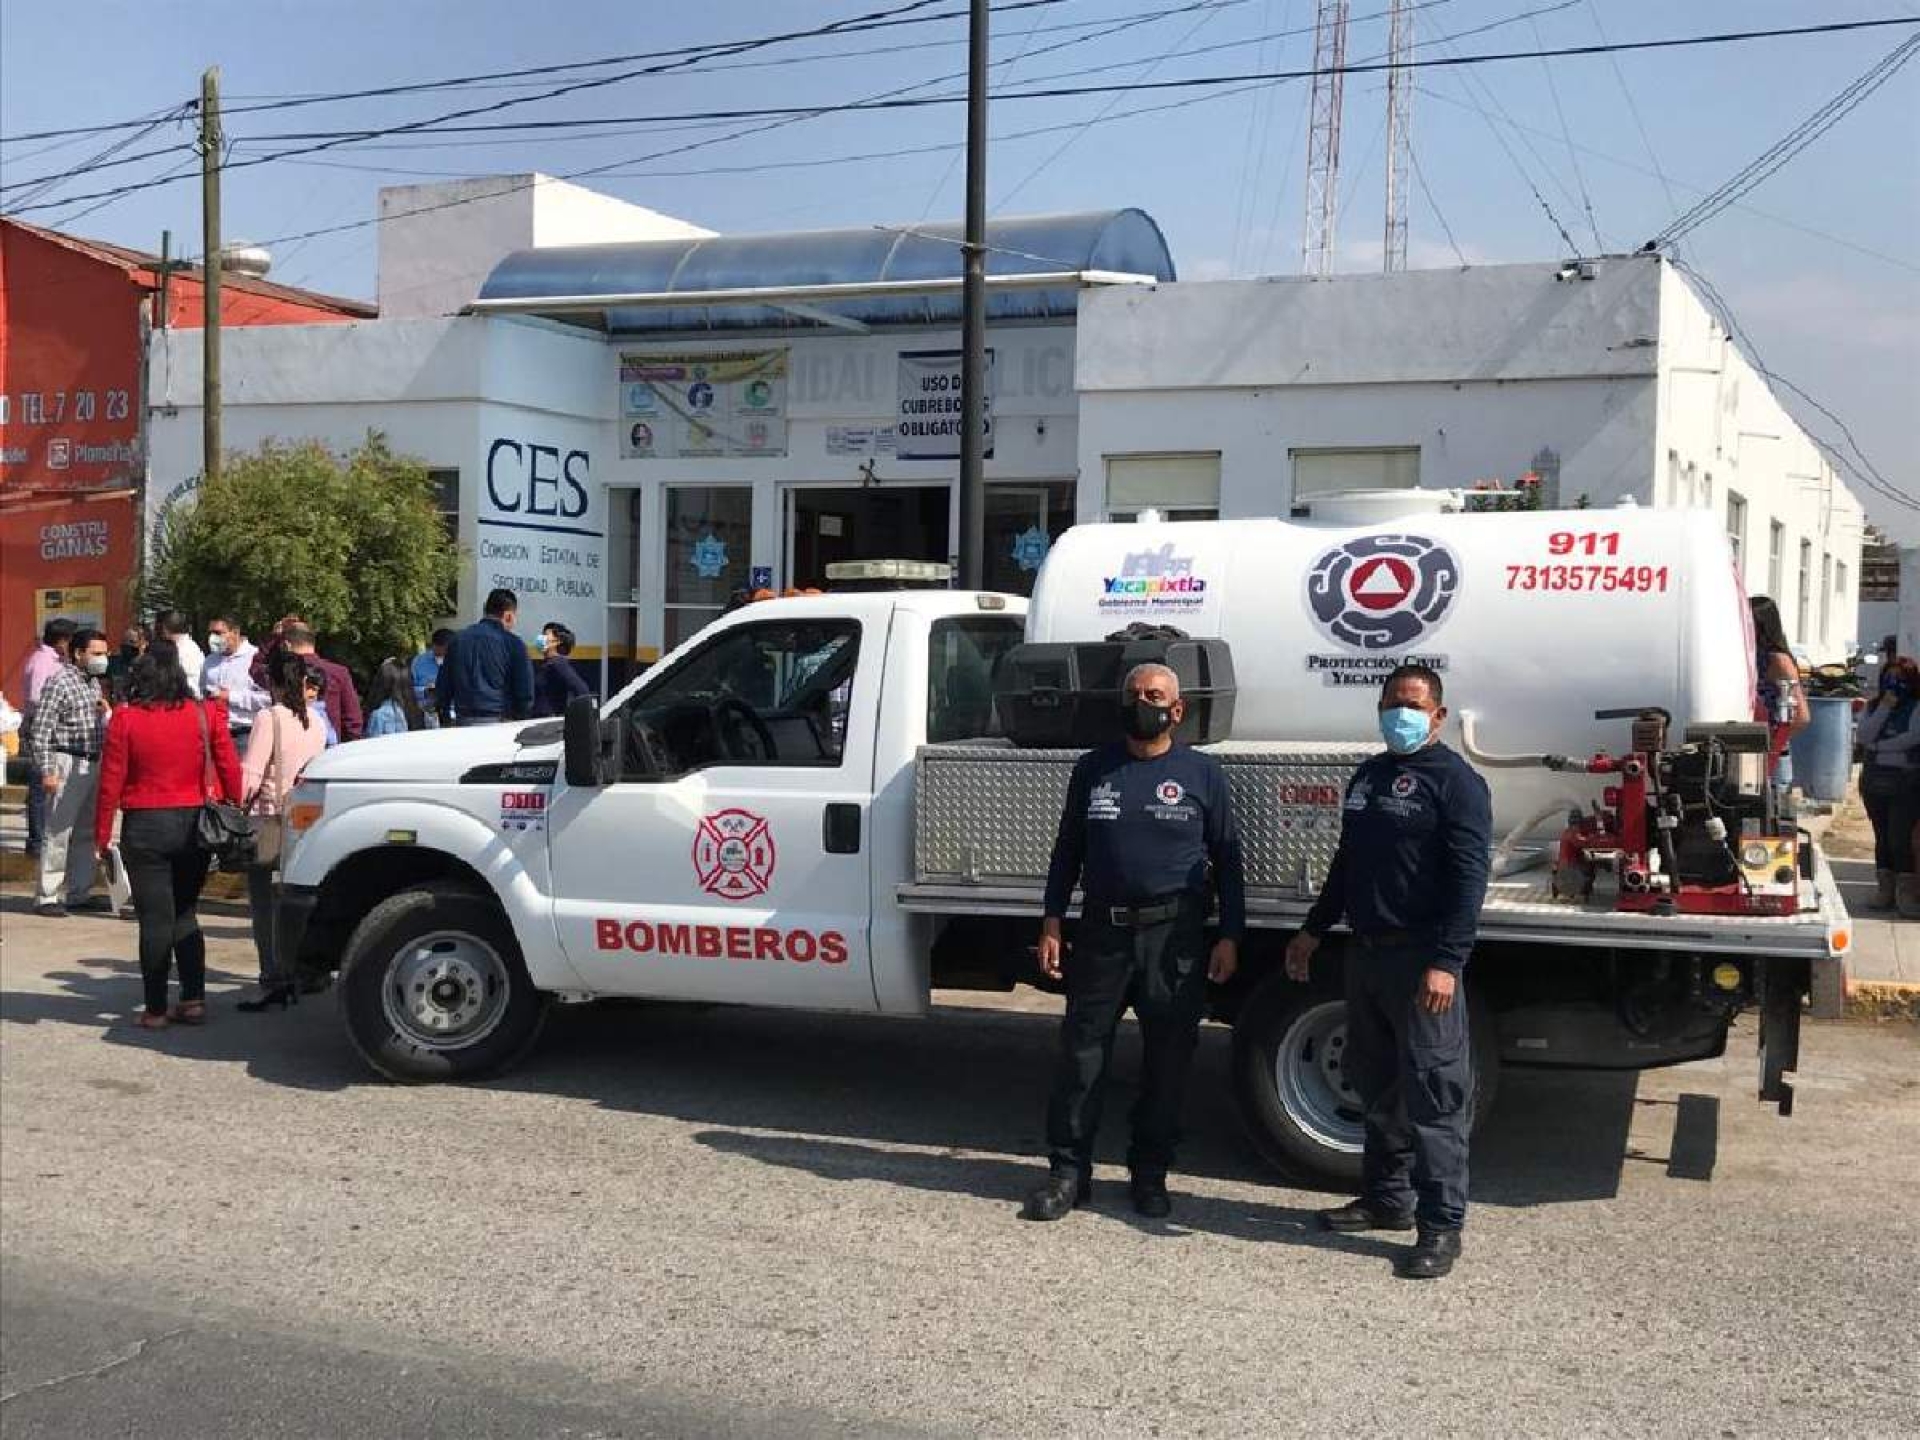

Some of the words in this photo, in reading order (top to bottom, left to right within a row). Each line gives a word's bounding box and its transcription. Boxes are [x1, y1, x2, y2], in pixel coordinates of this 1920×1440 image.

[922, 374, 948, 391] USO
[106, 390, 129, 420] 23
[487, 437, 590, 519] CES
[41, 536, 108, 560] GANAS
[1549, 532, 1620, 556] 911
[1104, 576, 1206, 598] Yecapixtla
[1506, 565, 1668, 592] 7313575491
[596, 918, 849, 964] BOMBEROS
